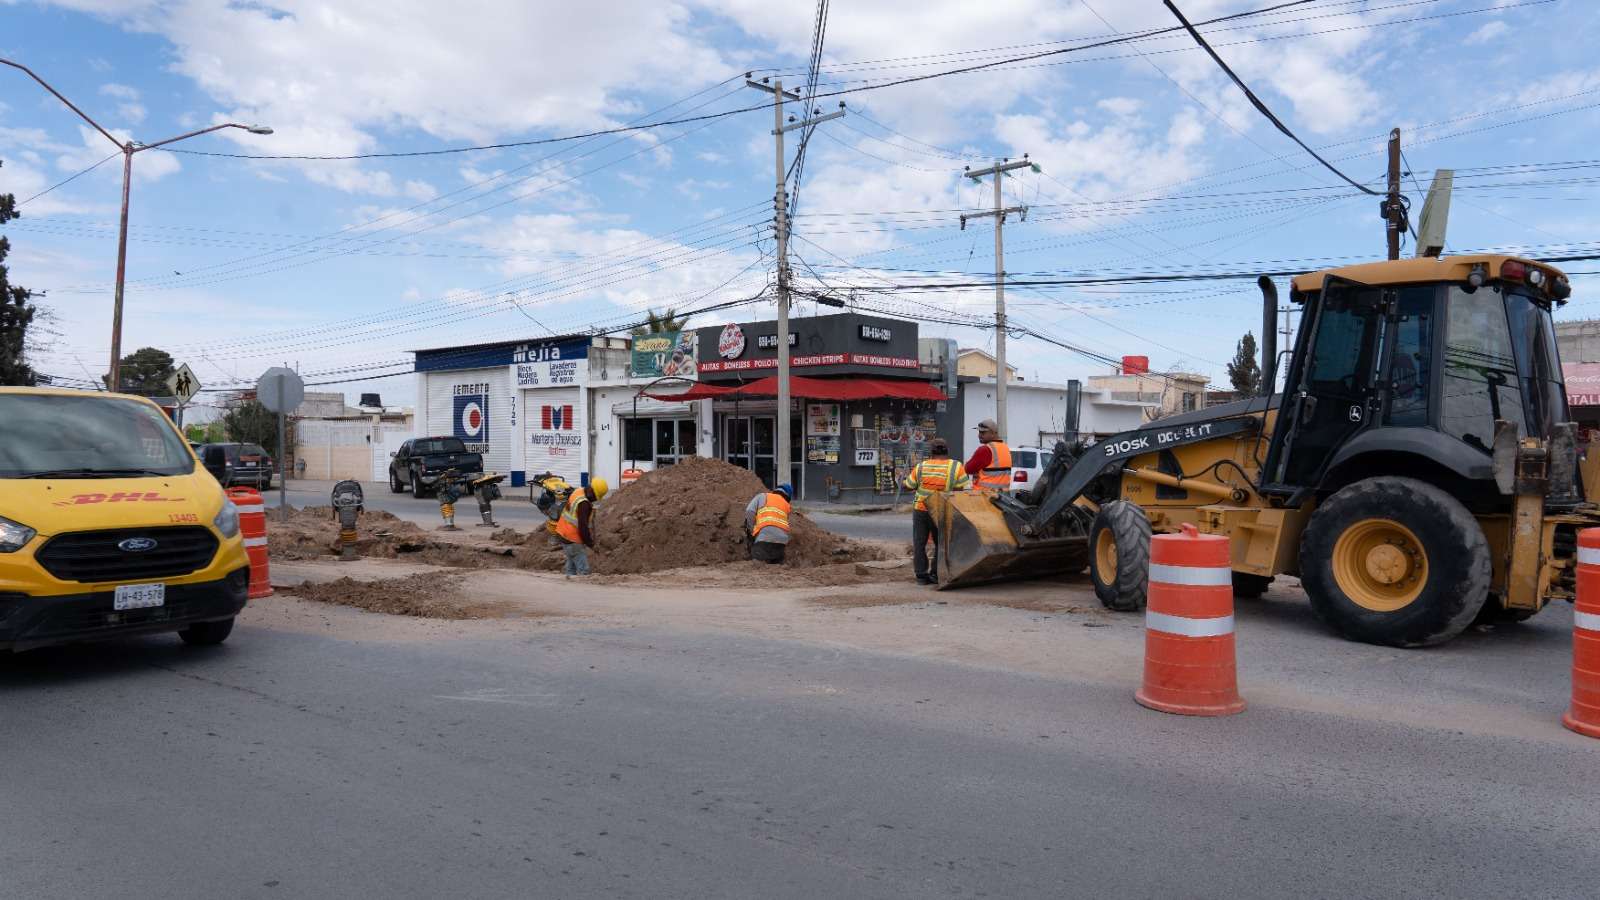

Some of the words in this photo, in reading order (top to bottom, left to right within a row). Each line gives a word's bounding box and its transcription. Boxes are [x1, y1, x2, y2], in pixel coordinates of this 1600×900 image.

[513, 342, 561, 363] Mejía
[724, 360, 751, 369] BONELESS
[755, 359, 772, 368] POLLO
[793, 356, 821, 366] CHICKEN
[822, 354, 844, 364] STRIPS
[1104, 435, 1150, 457] 310SK
[858, 452, 874, 461] 7727
[72, 492, 169, 505] DHL
